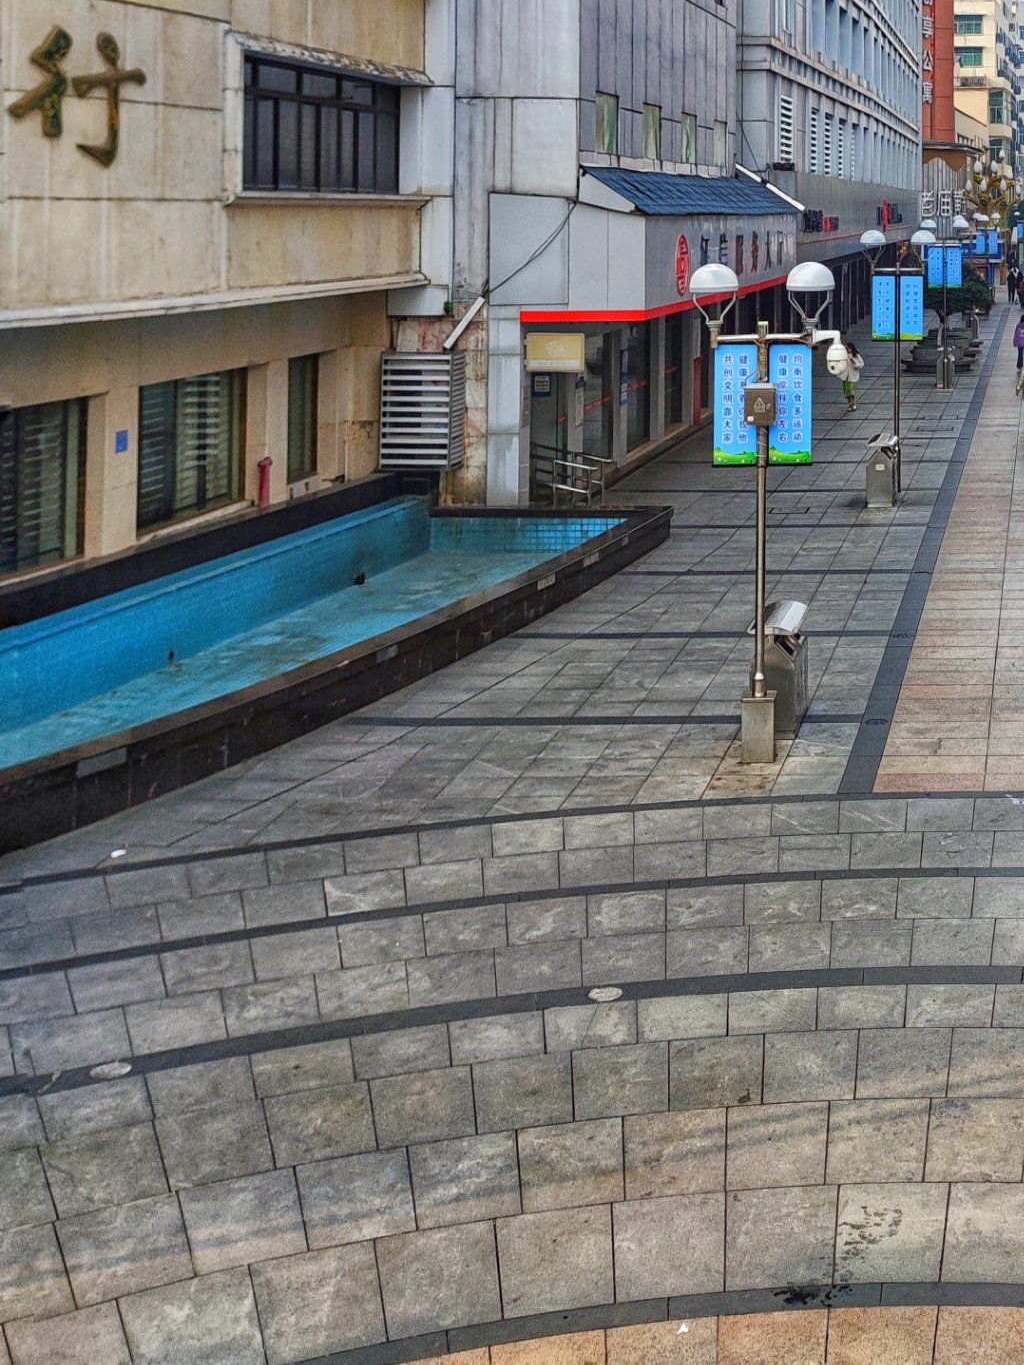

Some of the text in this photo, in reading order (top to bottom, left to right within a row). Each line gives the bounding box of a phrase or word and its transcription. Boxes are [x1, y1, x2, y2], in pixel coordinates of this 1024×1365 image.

[7, 24, 147, 169] 行
[723, 354, 734, 443] 共创文明靠大家
[778, 354, 788, 442] 健康常伴你左右
[793, 354, 804, 442] 均衡饮食多运动
